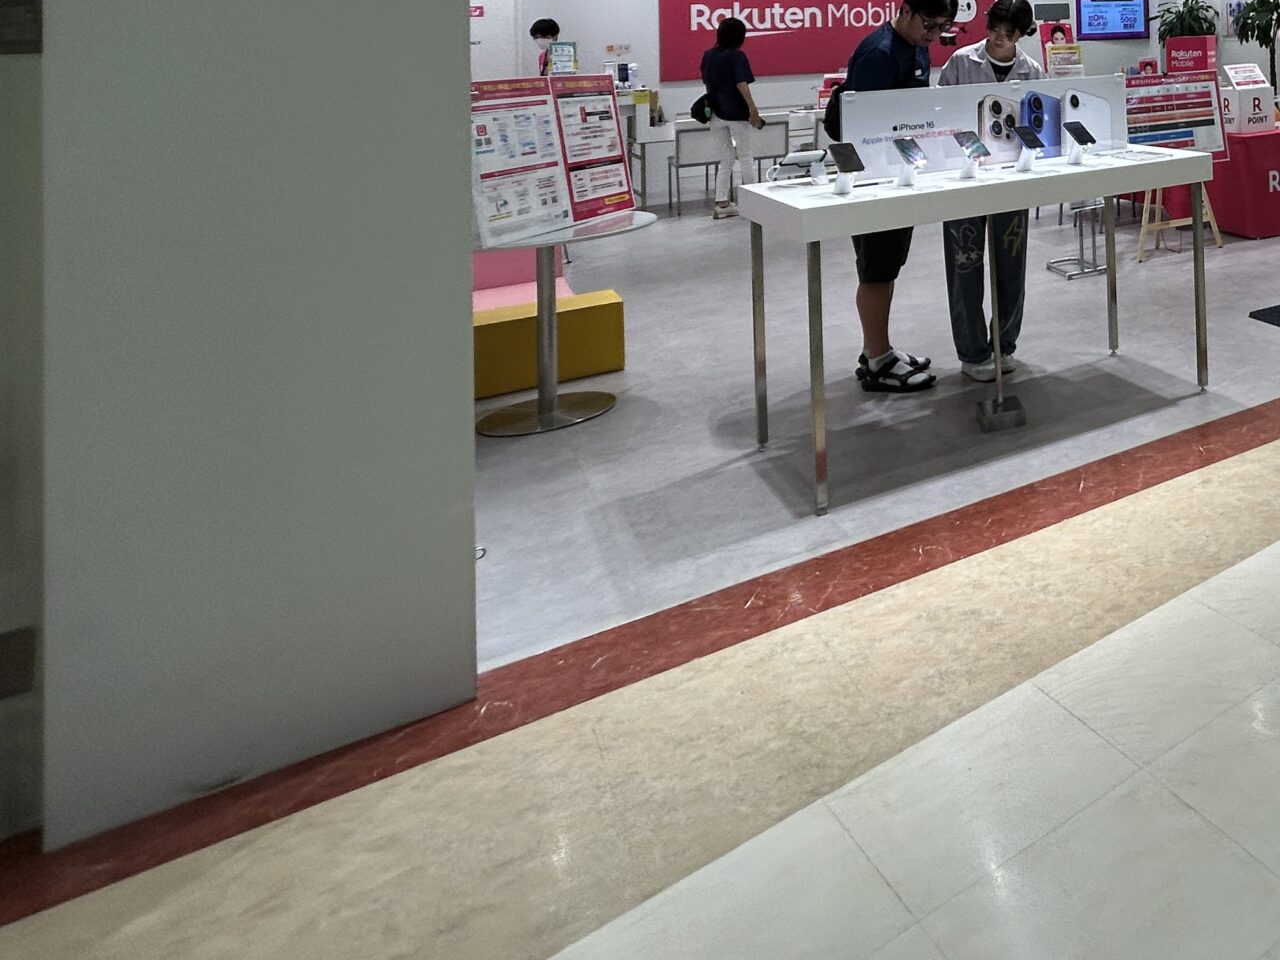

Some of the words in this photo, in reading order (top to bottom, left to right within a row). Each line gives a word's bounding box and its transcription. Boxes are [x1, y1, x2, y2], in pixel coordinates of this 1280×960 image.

[690, 1, 822, 35] Rakuten
[827, 1, 902, 28] Mobil
[1171, 49, 1202, 59] Rakuten
[1171, 59, 1194, 68] Mobile
[1252, 97, 1262, 112] R
[1247, 115, 1268, 125] POINT
[898, 122, 925, 132] iPhone
[926, 120, 935, 129] 16
